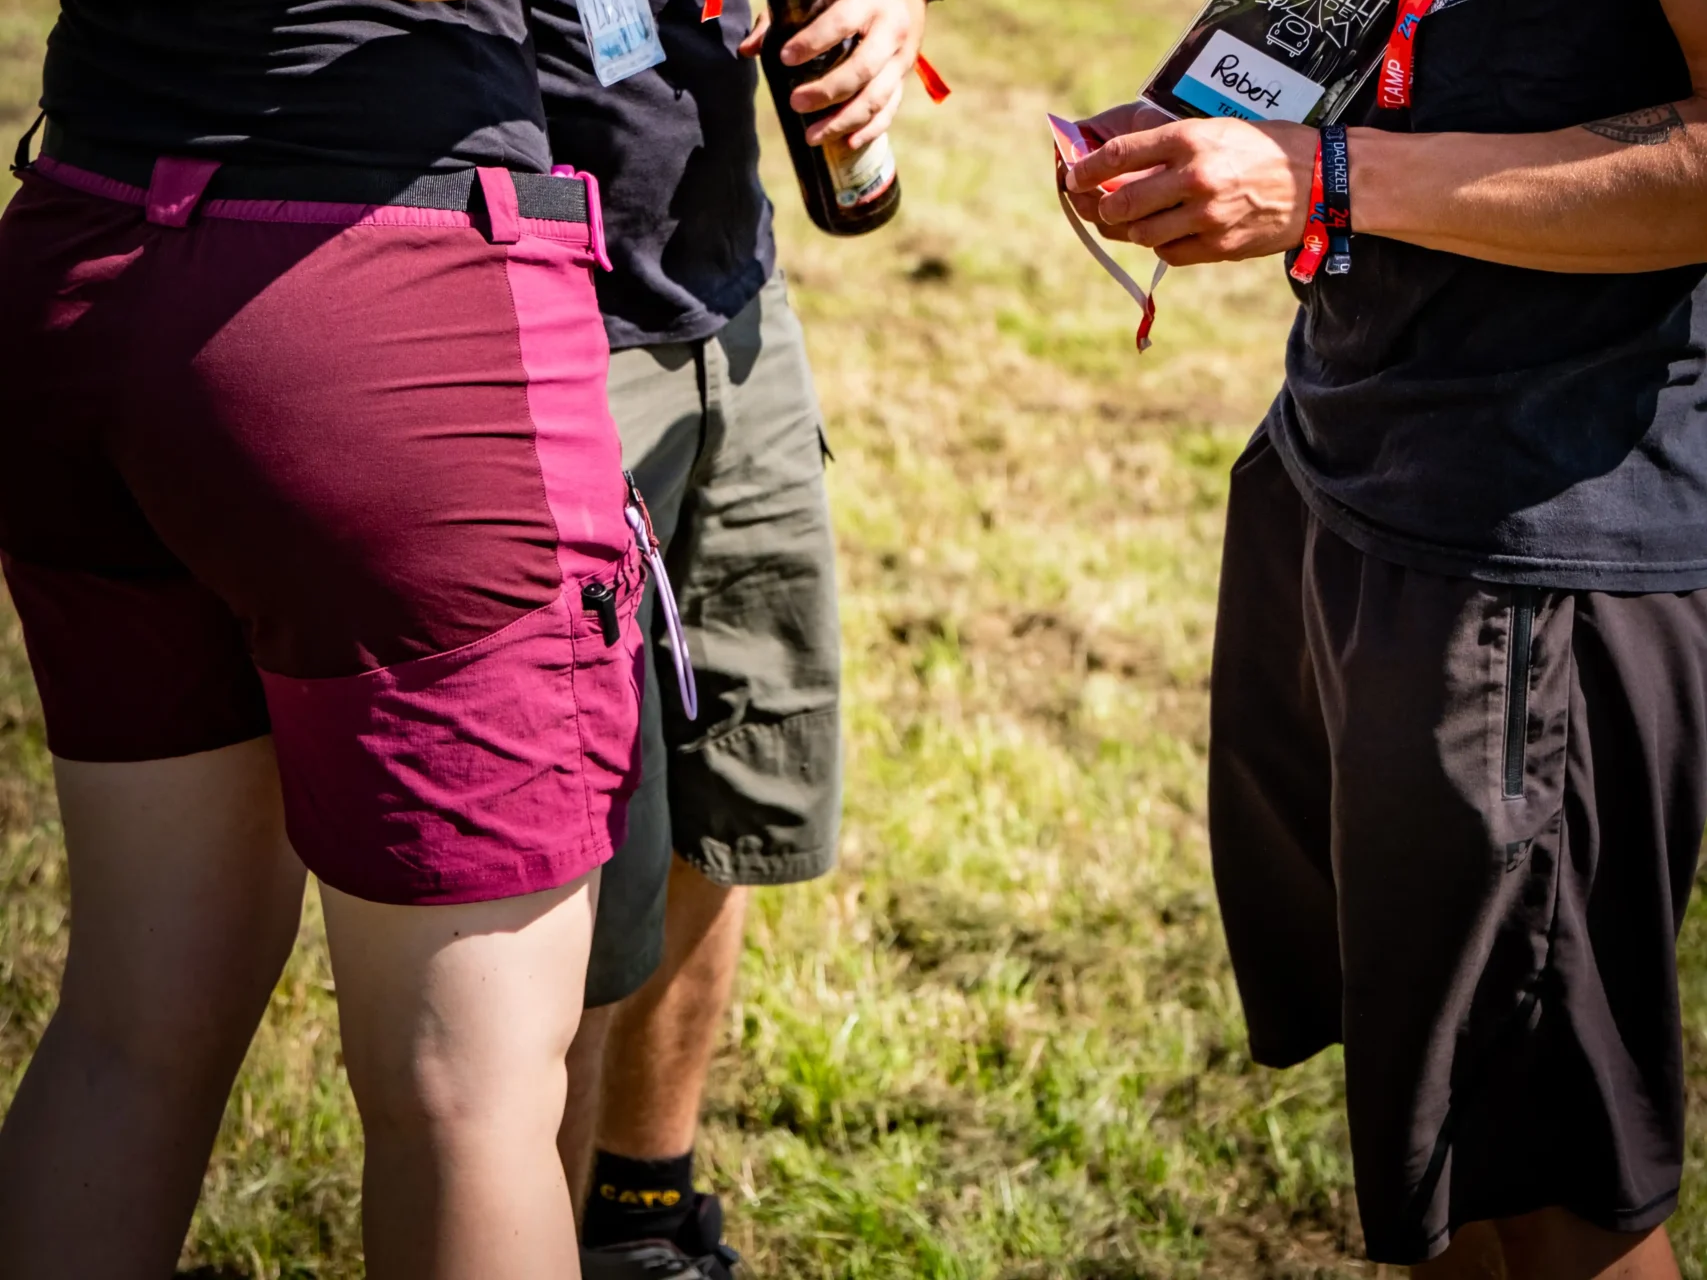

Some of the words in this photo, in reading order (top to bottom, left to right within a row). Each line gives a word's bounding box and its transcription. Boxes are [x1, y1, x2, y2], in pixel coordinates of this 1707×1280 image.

[1210, 54, 1281, 109] Robert
[1384, 59, 1404, 104] CAMP
[1398, 12, 1421, 39] 24
[1333, 141, 1348, 195] DACHZELT
[1325, 207, 1349, 228] 24
